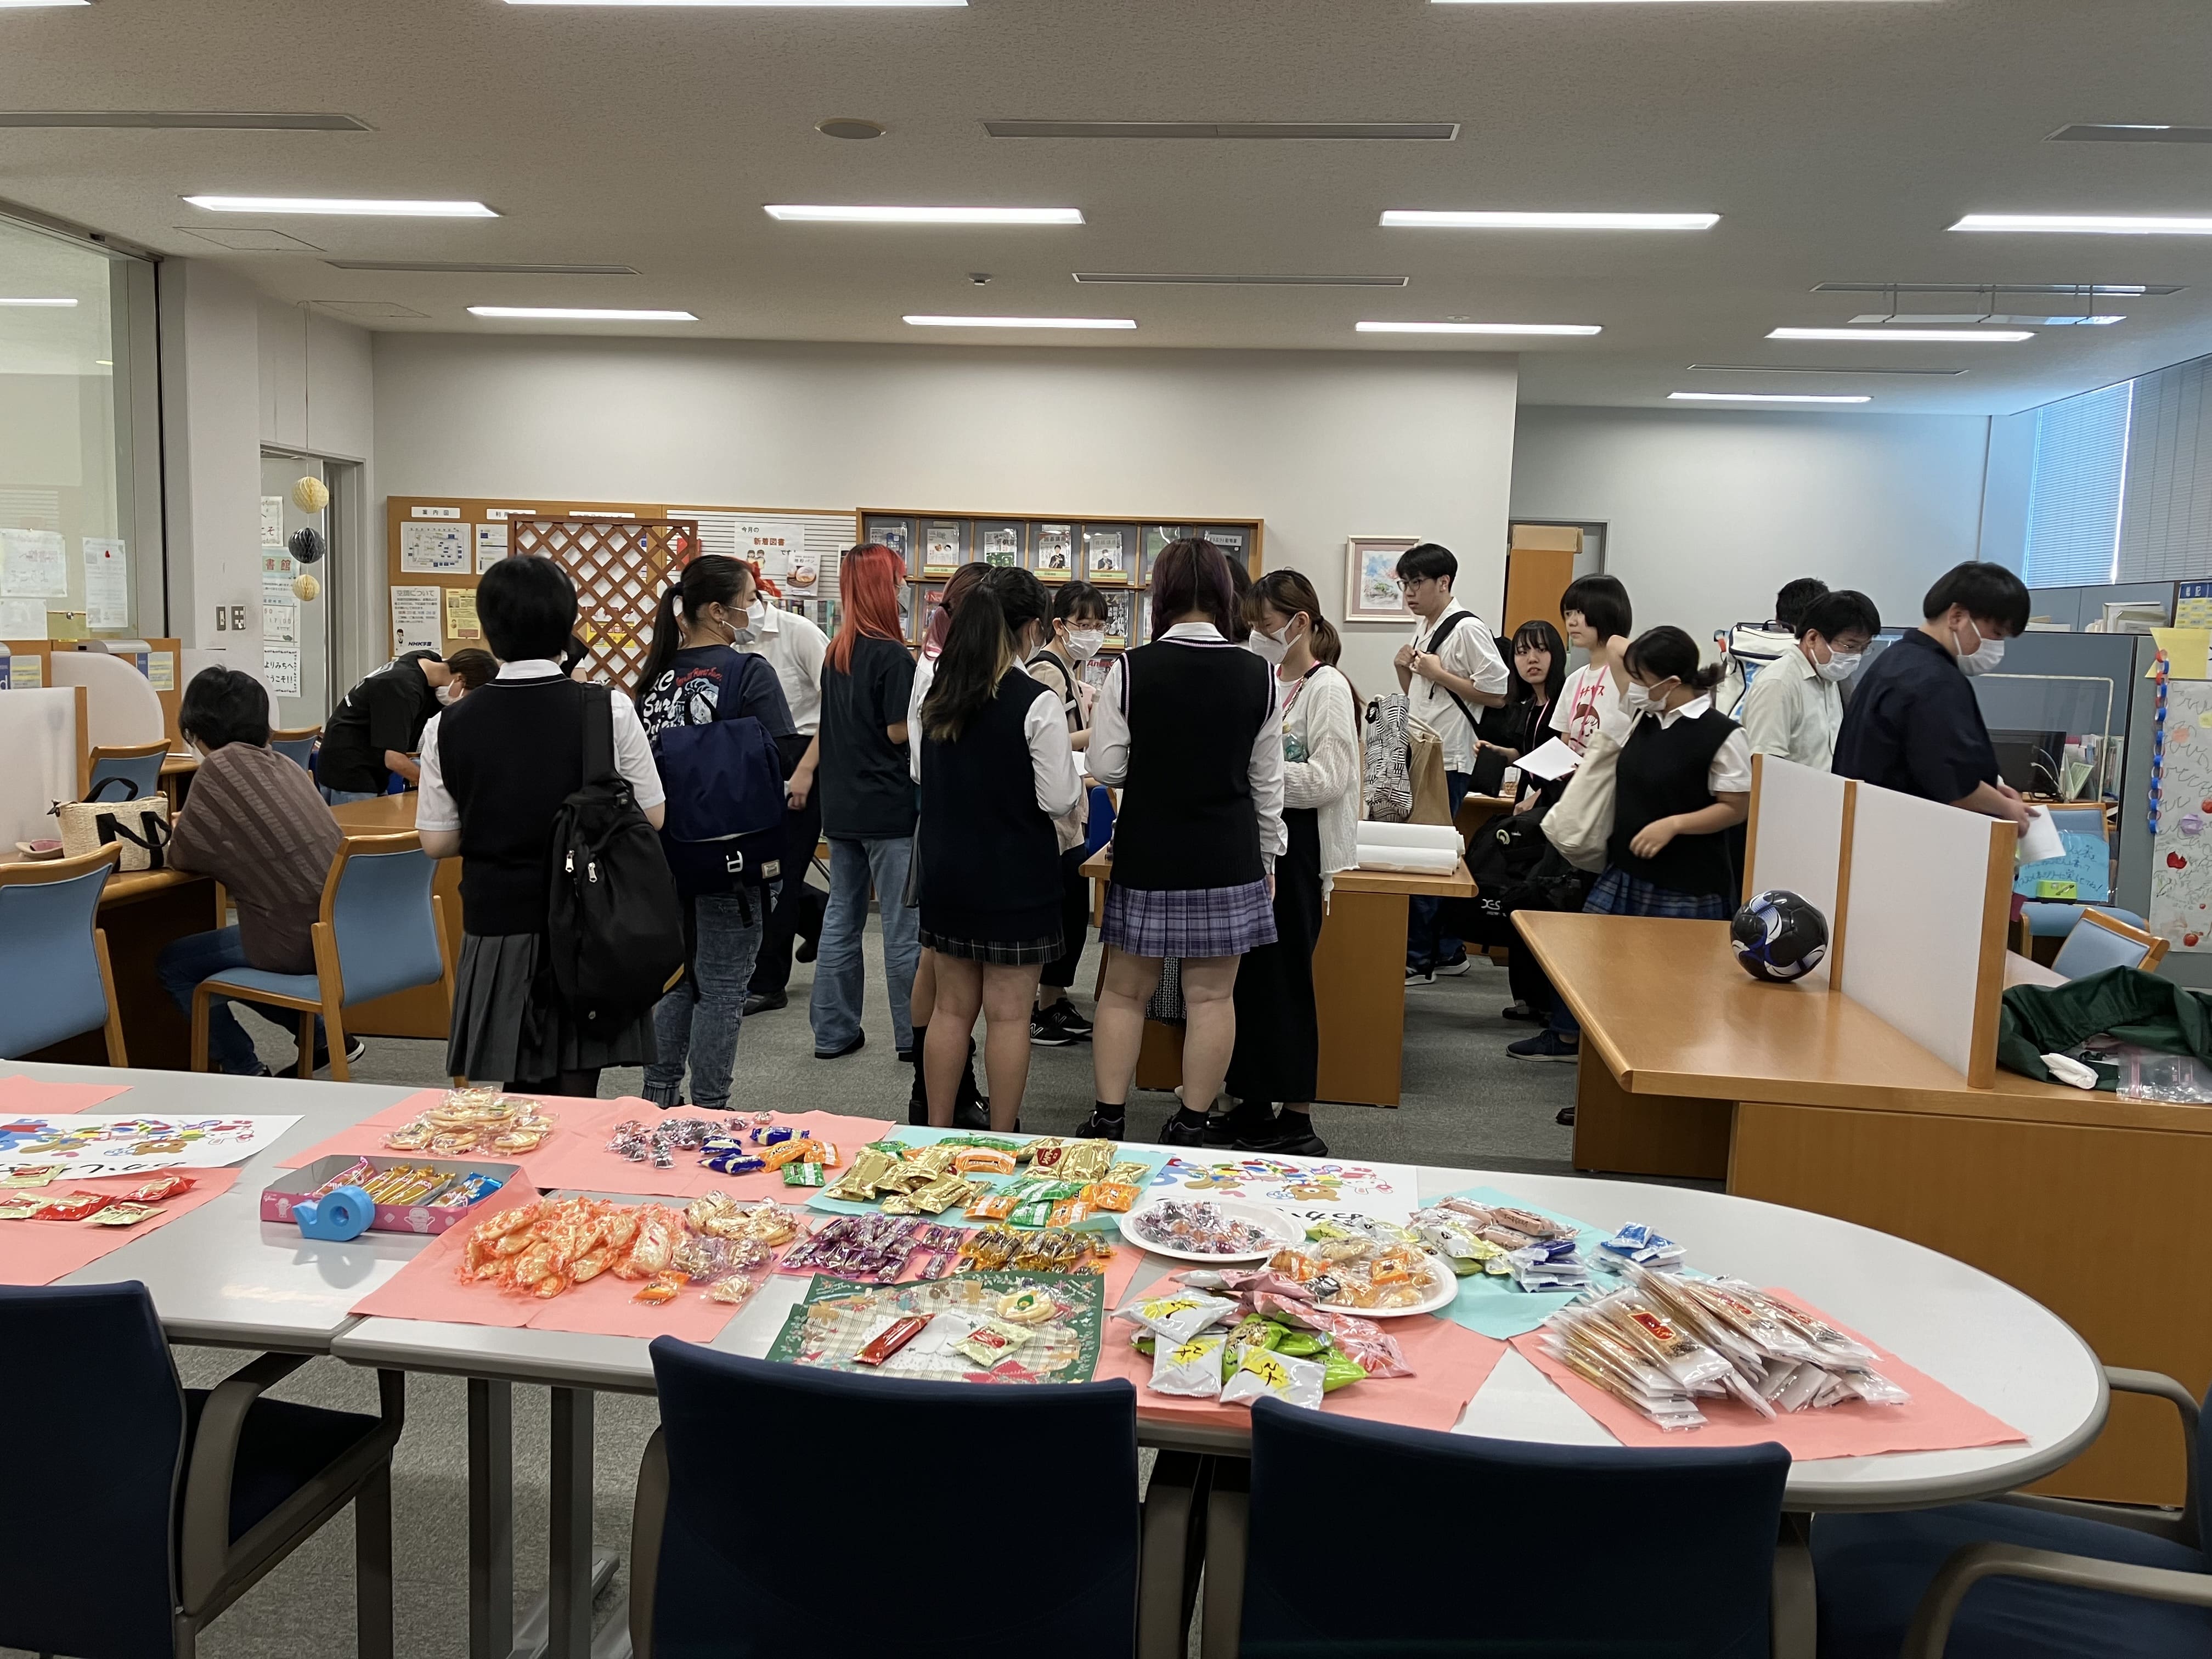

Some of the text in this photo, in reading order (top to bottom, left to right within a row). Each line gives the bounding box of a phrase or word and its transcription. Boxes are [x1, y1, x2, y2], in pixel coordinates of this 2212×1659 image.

[754, 537, 786, 546] 新着図書
[264, 661, 294, 669] よりみちへ
